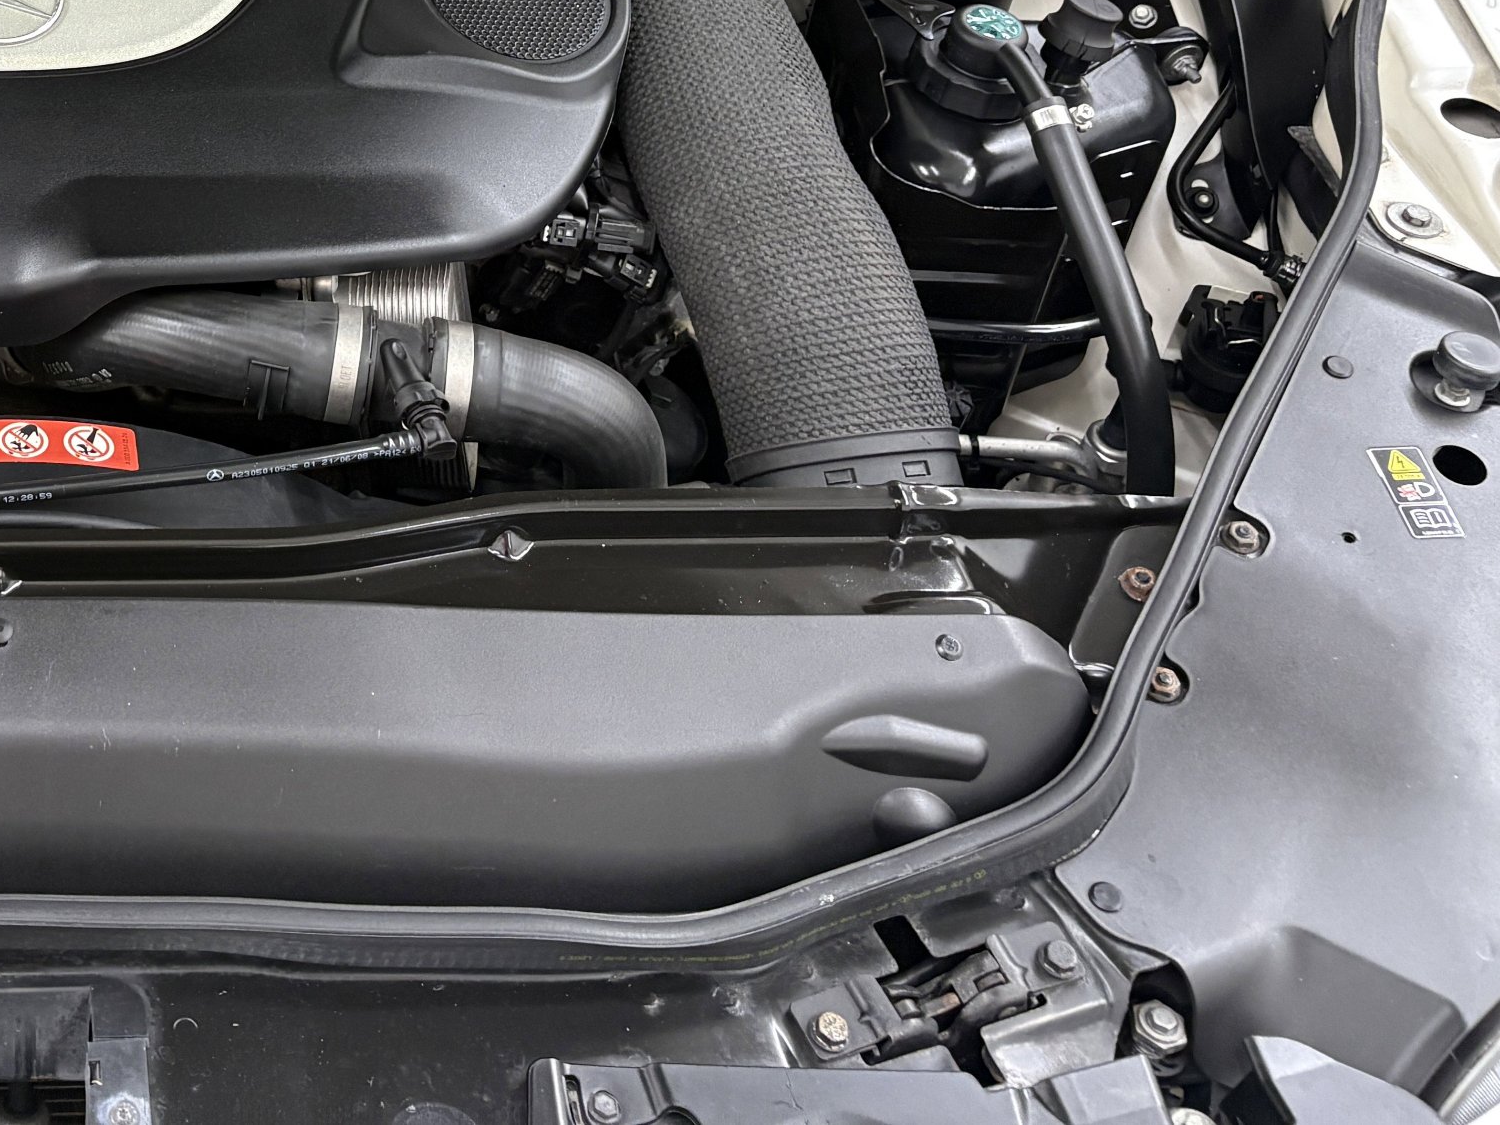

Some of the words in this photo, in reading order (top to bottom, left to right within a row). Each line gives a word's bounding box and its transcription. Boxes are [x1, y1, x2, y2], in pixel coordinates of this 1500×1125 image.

[231, 463, 299, 479] A2305010925
[321, 452, 369, 466] 21/06/08
[2, 492, 53, 504] 12:28:59
